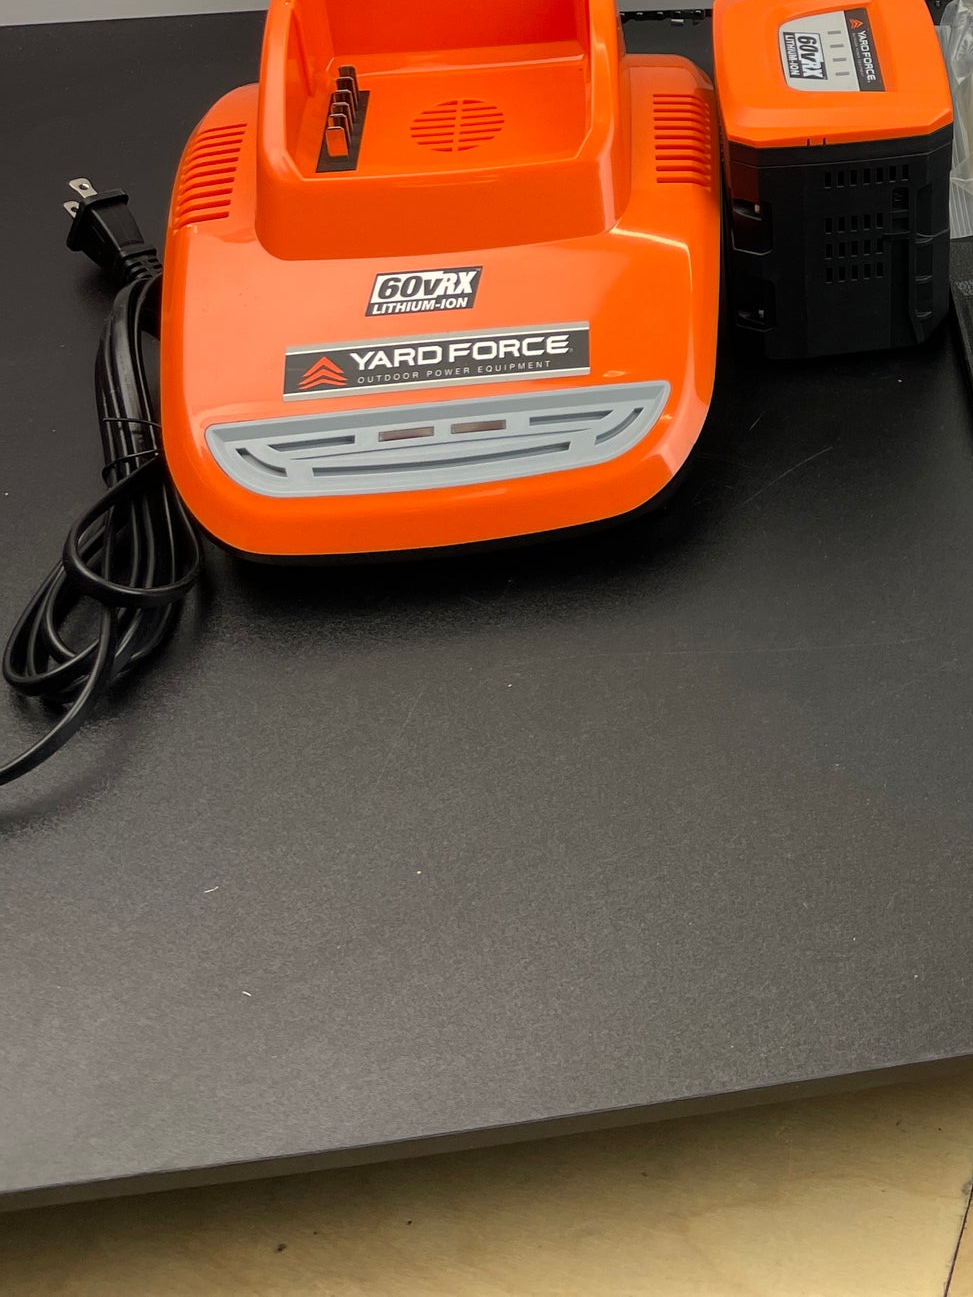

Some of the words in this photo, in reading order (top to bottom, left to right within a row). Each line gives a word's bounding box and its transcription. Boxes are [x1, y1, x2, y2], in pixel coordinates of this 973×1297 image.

[857, 30, 870, 52] YARD
[862, 52, 876, 81] FORCE
[372, 297, 468, 315] LITHIUM-ION
[350, 345, 443, 371] YARD
[448, 334, 570, 363] FORCE
[357, 371, 419, 384] OUTDOOR
[426, 366, 470, 377] POWER
[477, 360, 551, 373] EQUIPMENT
